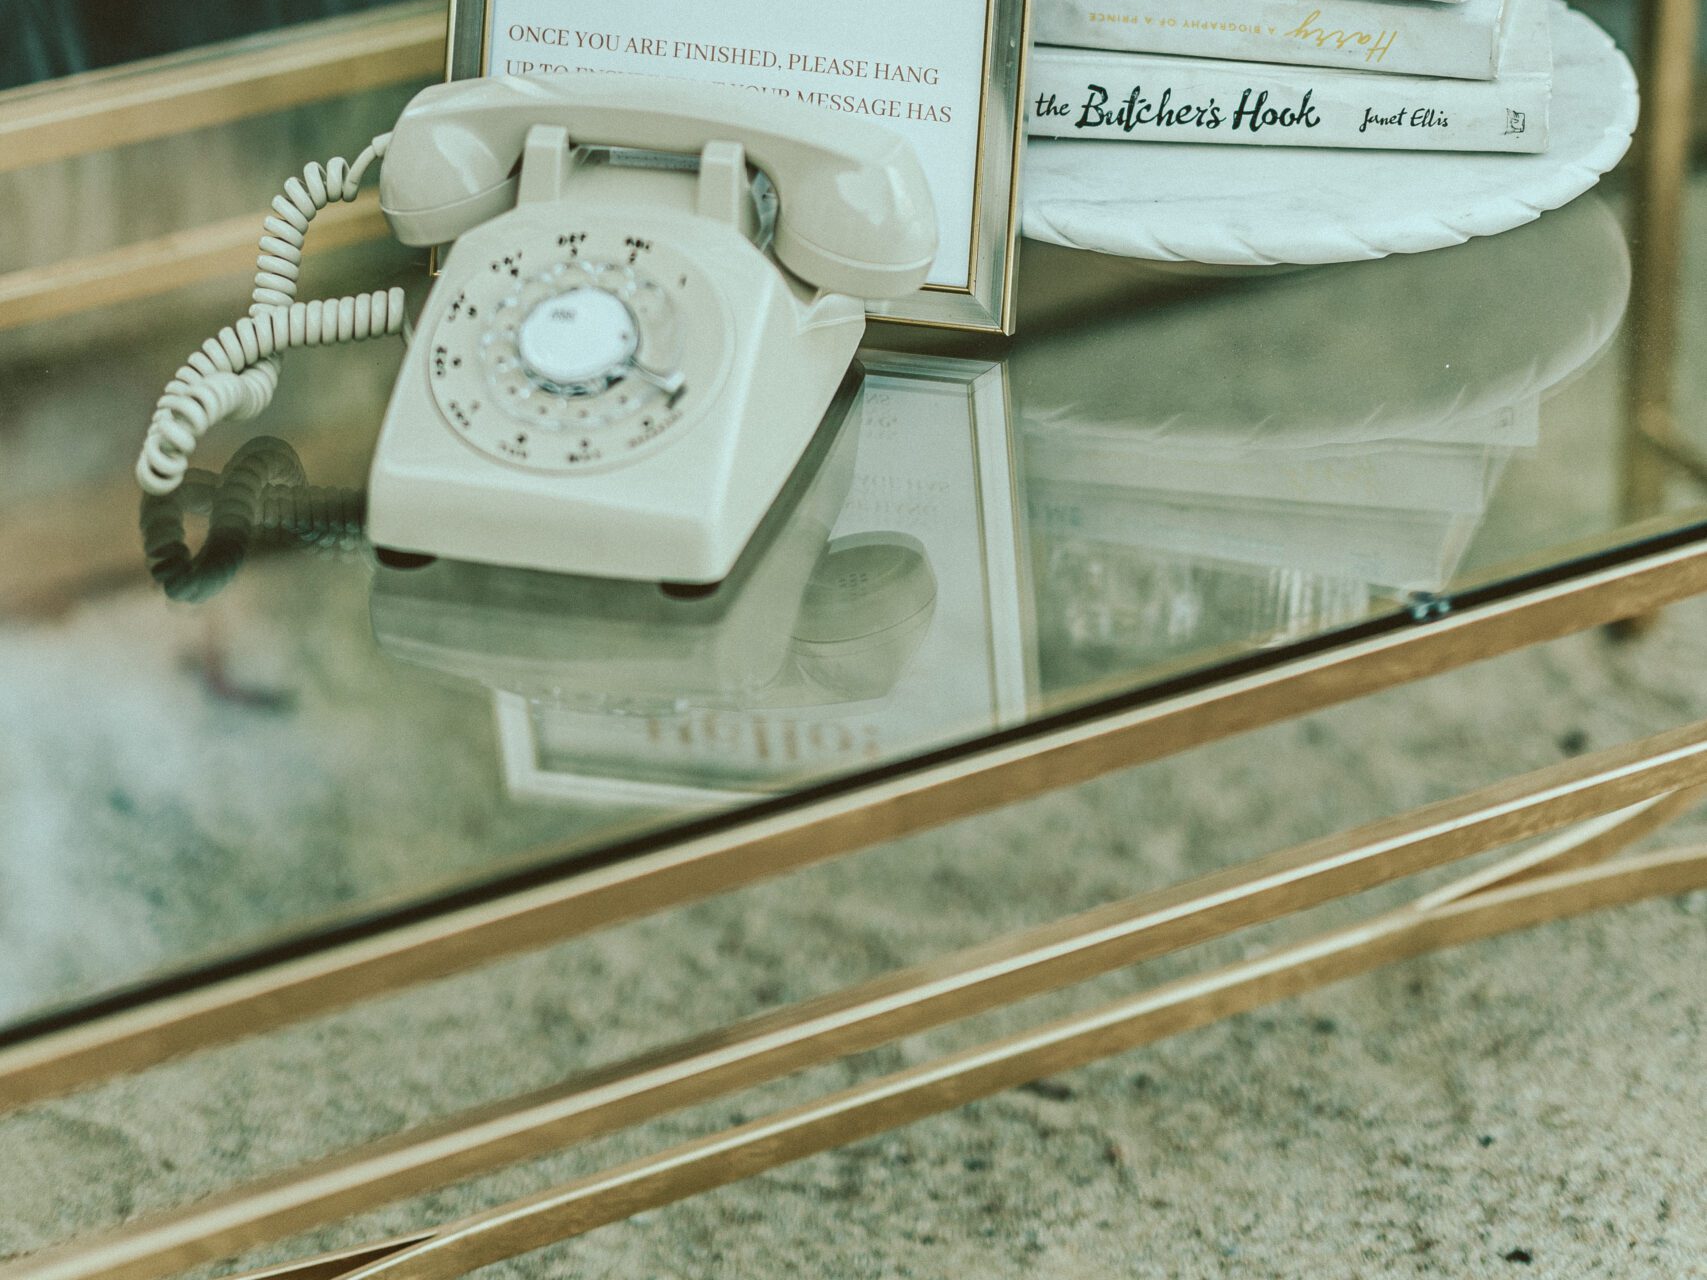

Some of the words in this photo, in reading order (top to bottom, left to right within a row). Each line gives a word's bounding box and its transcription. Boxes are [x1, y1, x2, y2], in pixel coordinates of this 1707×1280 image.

[1088, 12, 1138, 25] PRINCE
[1144, 16, 1153, 25] A
[1159, 16, 1176, 27] OF
[1183, 20, 1261, 34] BIOGRAPHY
[1269, 27, 1277, 35] A
[1285, 9, 1398, 62] Harry
[509, 25, 569, 46] ONCE
[575, 31, 619, 50] YOU
[625, 37, 667, 56] ARE
[673, 42, 781, 70] FINISHED,
[789, 54, 868, 77] PLEASE
[874, 63, 938, 84] HANG
[906, 103, 951, 122] HAS
[1035, 92, 1071, 118] the
[1075, 84, 1227, 132] Butcher's
[1232, 88, 1320, 132] Hook
[1359, 107, 1407, 133] Janet
[1410, 108, 1449, 128] Ellis
